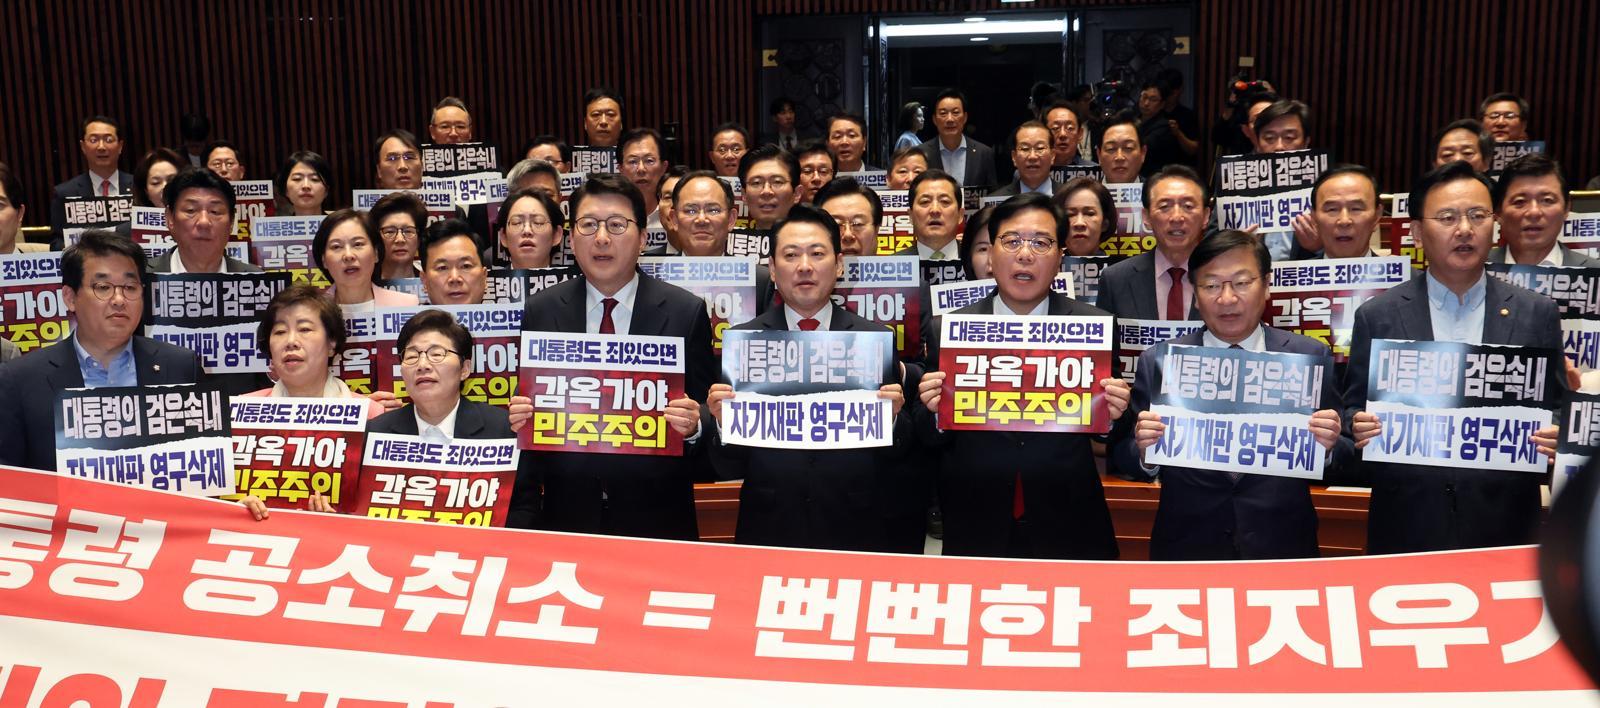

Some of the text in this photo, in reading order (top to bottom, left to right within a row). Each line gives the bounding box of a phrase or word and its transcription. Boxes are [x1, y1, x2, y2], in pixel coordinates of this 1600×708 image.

[457, 146, 497, 170] 검은속내
[571, 150, 611, 175] 대통령의
[1220, 159, 1273, 191] 대통령의
[65, 198, 133, 225] 대통령의 검은
[1223, 199, 1275, 230] 자기재판
[1563, 218, 1600, 238] 대통
[255, 219, 307, 238] 대통령도
[686, 262, 750, 282] 죄있으면
[848, 261, 913, 283] 죄있으면
[1333, 262, 1403, 285] 죄있으면
[151, 279, 218, 318] 대통령의
[456, 309, 524, 332] 죄있으면
[949, 320, 1105, 346] 대통령도 죄있으면
[528, 338, 679, 367] 대통령도 죄있으면
[730, 339, 885, 384] 대통령의 검은속내
[954, 355, 1095, 389] 감옥가야
[1160, 354, 1240, 403] 대통령의
[1243, 360, 1325, 410] 검은속내
[1376, 348, 1548, 402] 대통령의 검은속내
[534, 375, 669, 412] 감옥가야
[953, 390, 1093, 426] 민주주의
[62, 390, 223, 439] 대통령의 검은속내
[230, 402, 361, 426] 대통령도 죄있으면
[533, 411, 668, 448] 민주주의
[730, 400, 884, 442] 자기재판 영구삭제
[371, 440, 515, 467] 대통령도 죄있으면
[1154, 415, 1317, 472] 자기재판 영구삭제
[1371, 410, 1542, 465] 자기재판 영구삭제
[150, 448, 227, 492] 영구삭제
[371, 473, 500, 509] 감옥가야
[182, 527, 605, 645] 공소취소
[754, 575, 1093, 669] 뻔뻔한
